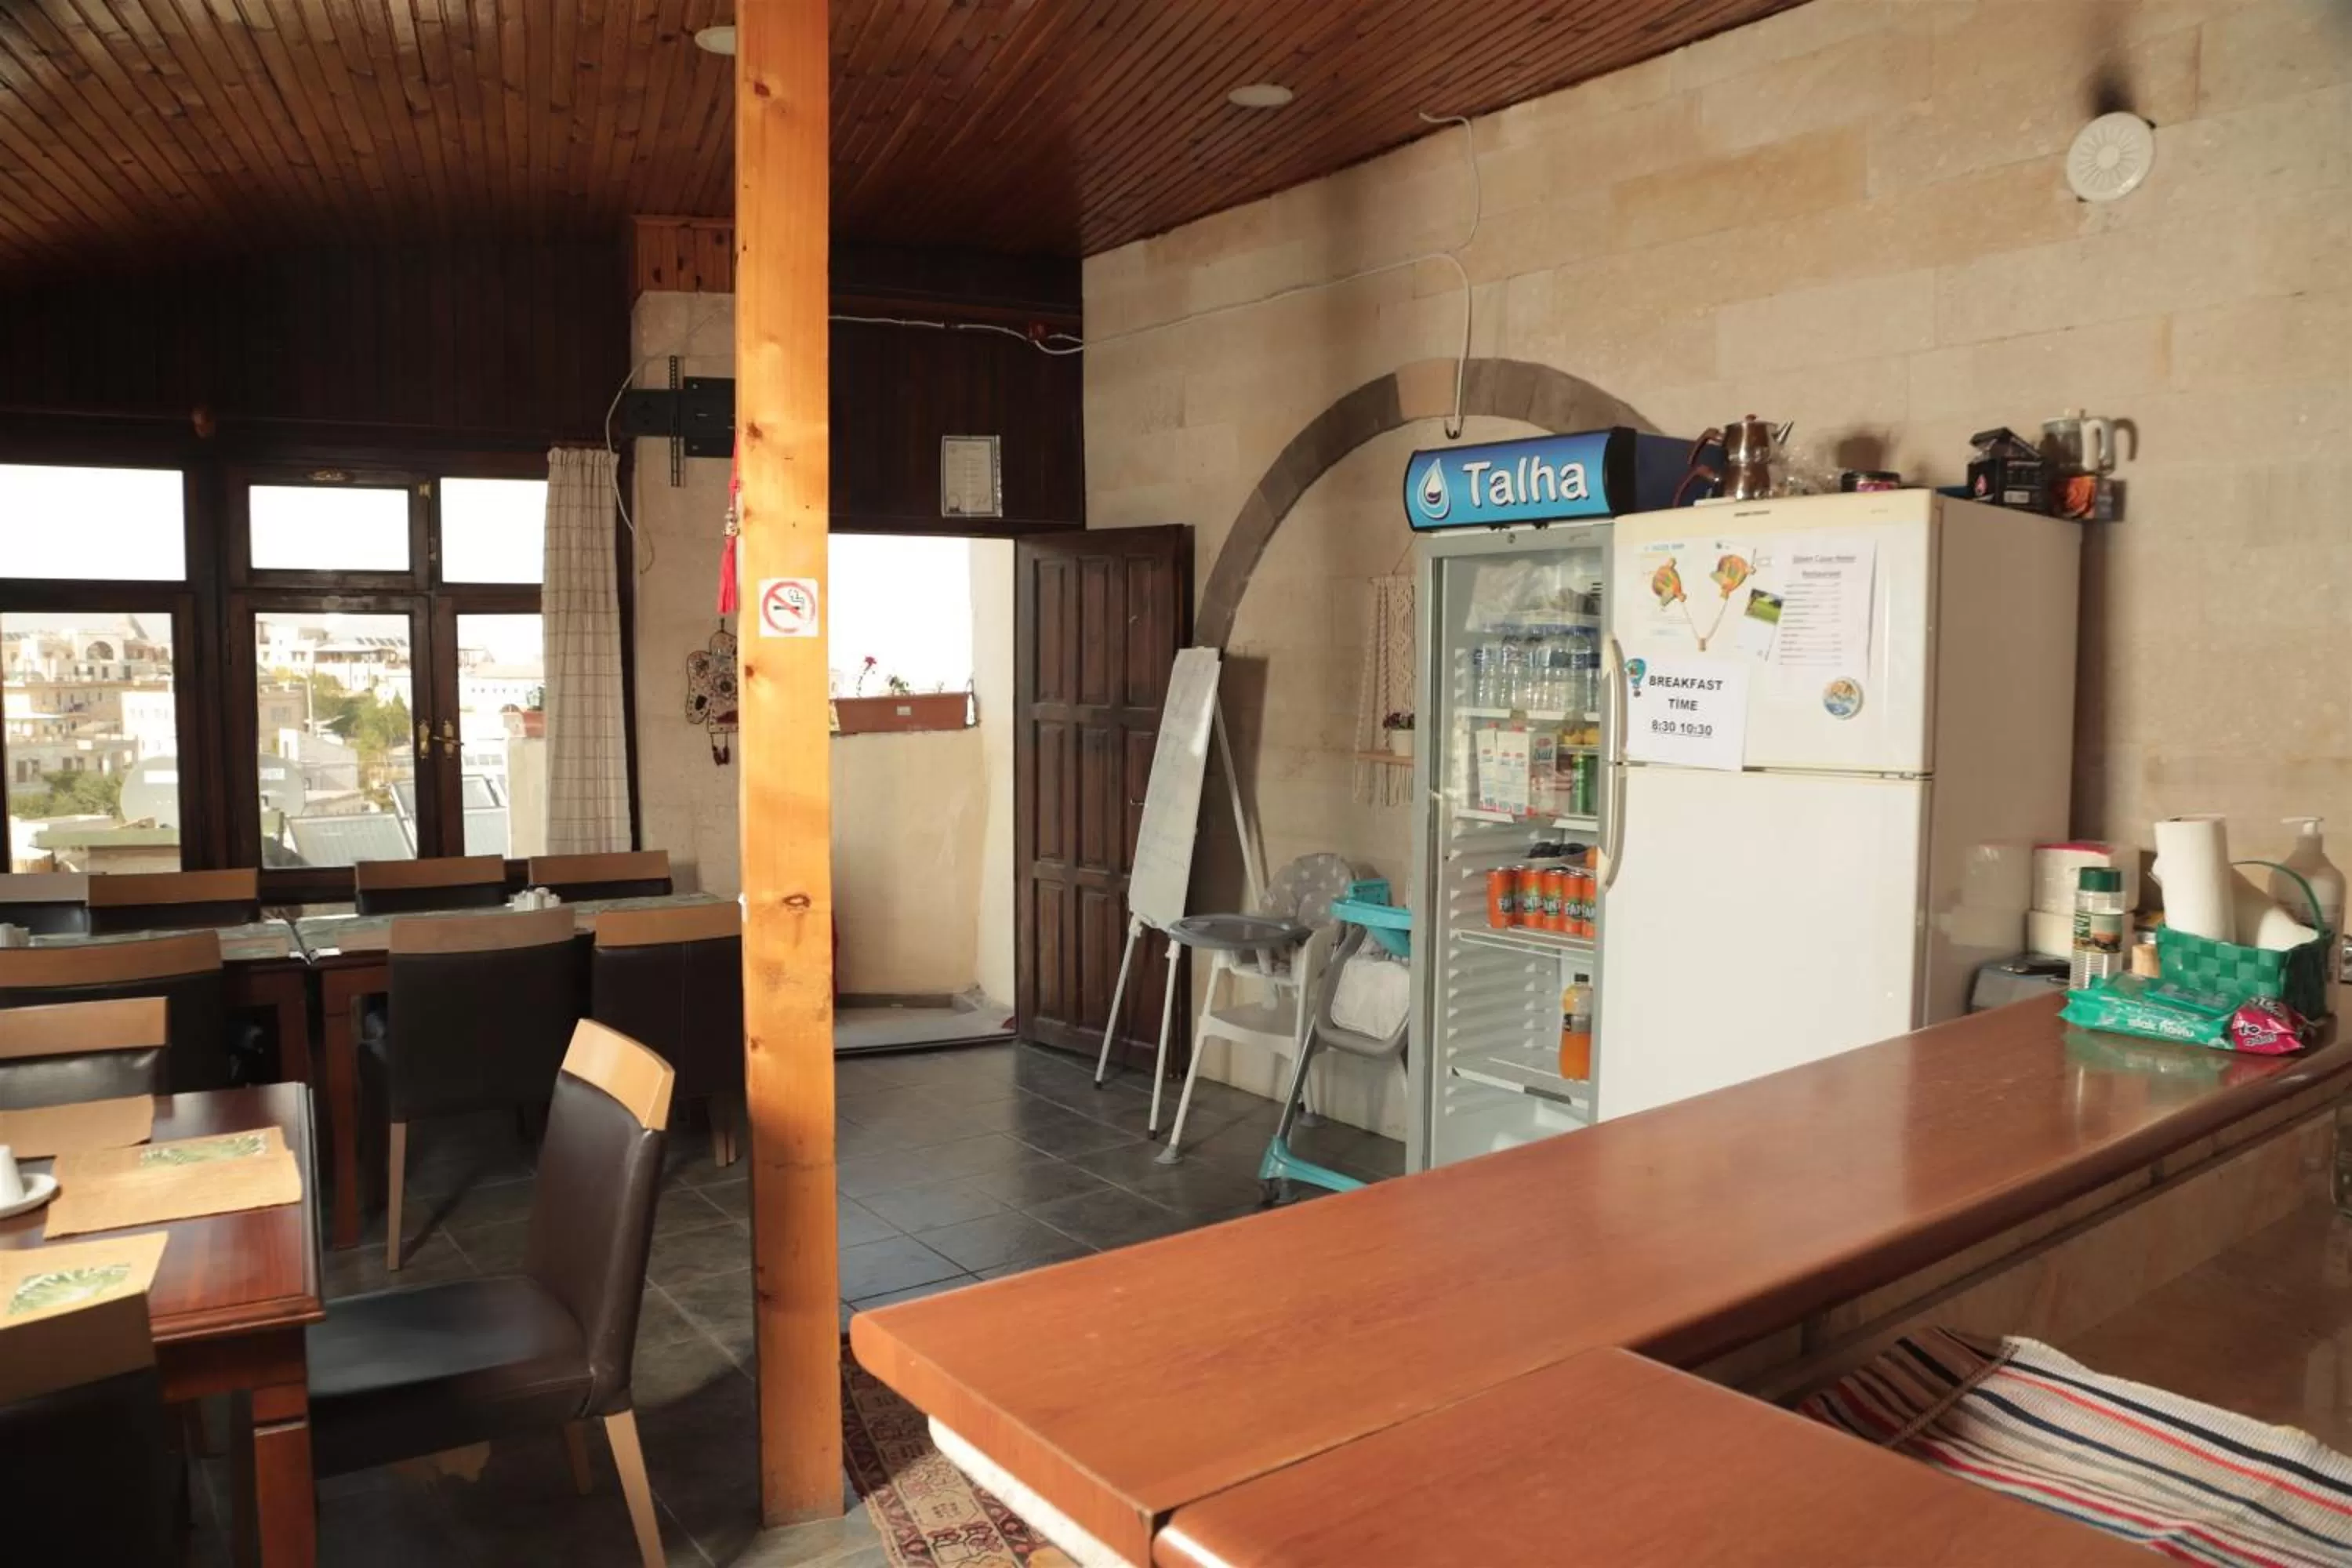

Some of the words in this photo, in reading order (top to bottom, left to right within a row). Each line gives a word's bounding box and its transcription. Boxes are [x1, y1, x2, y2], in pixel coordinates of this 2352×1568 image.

[1462, 456, 1589, 509] Talha
[1649, 675, 1723, 691] BREAKFAST
[1652, 719, 1676, 732] 8:30
[1680, 722, 1713, 737] 10:30
